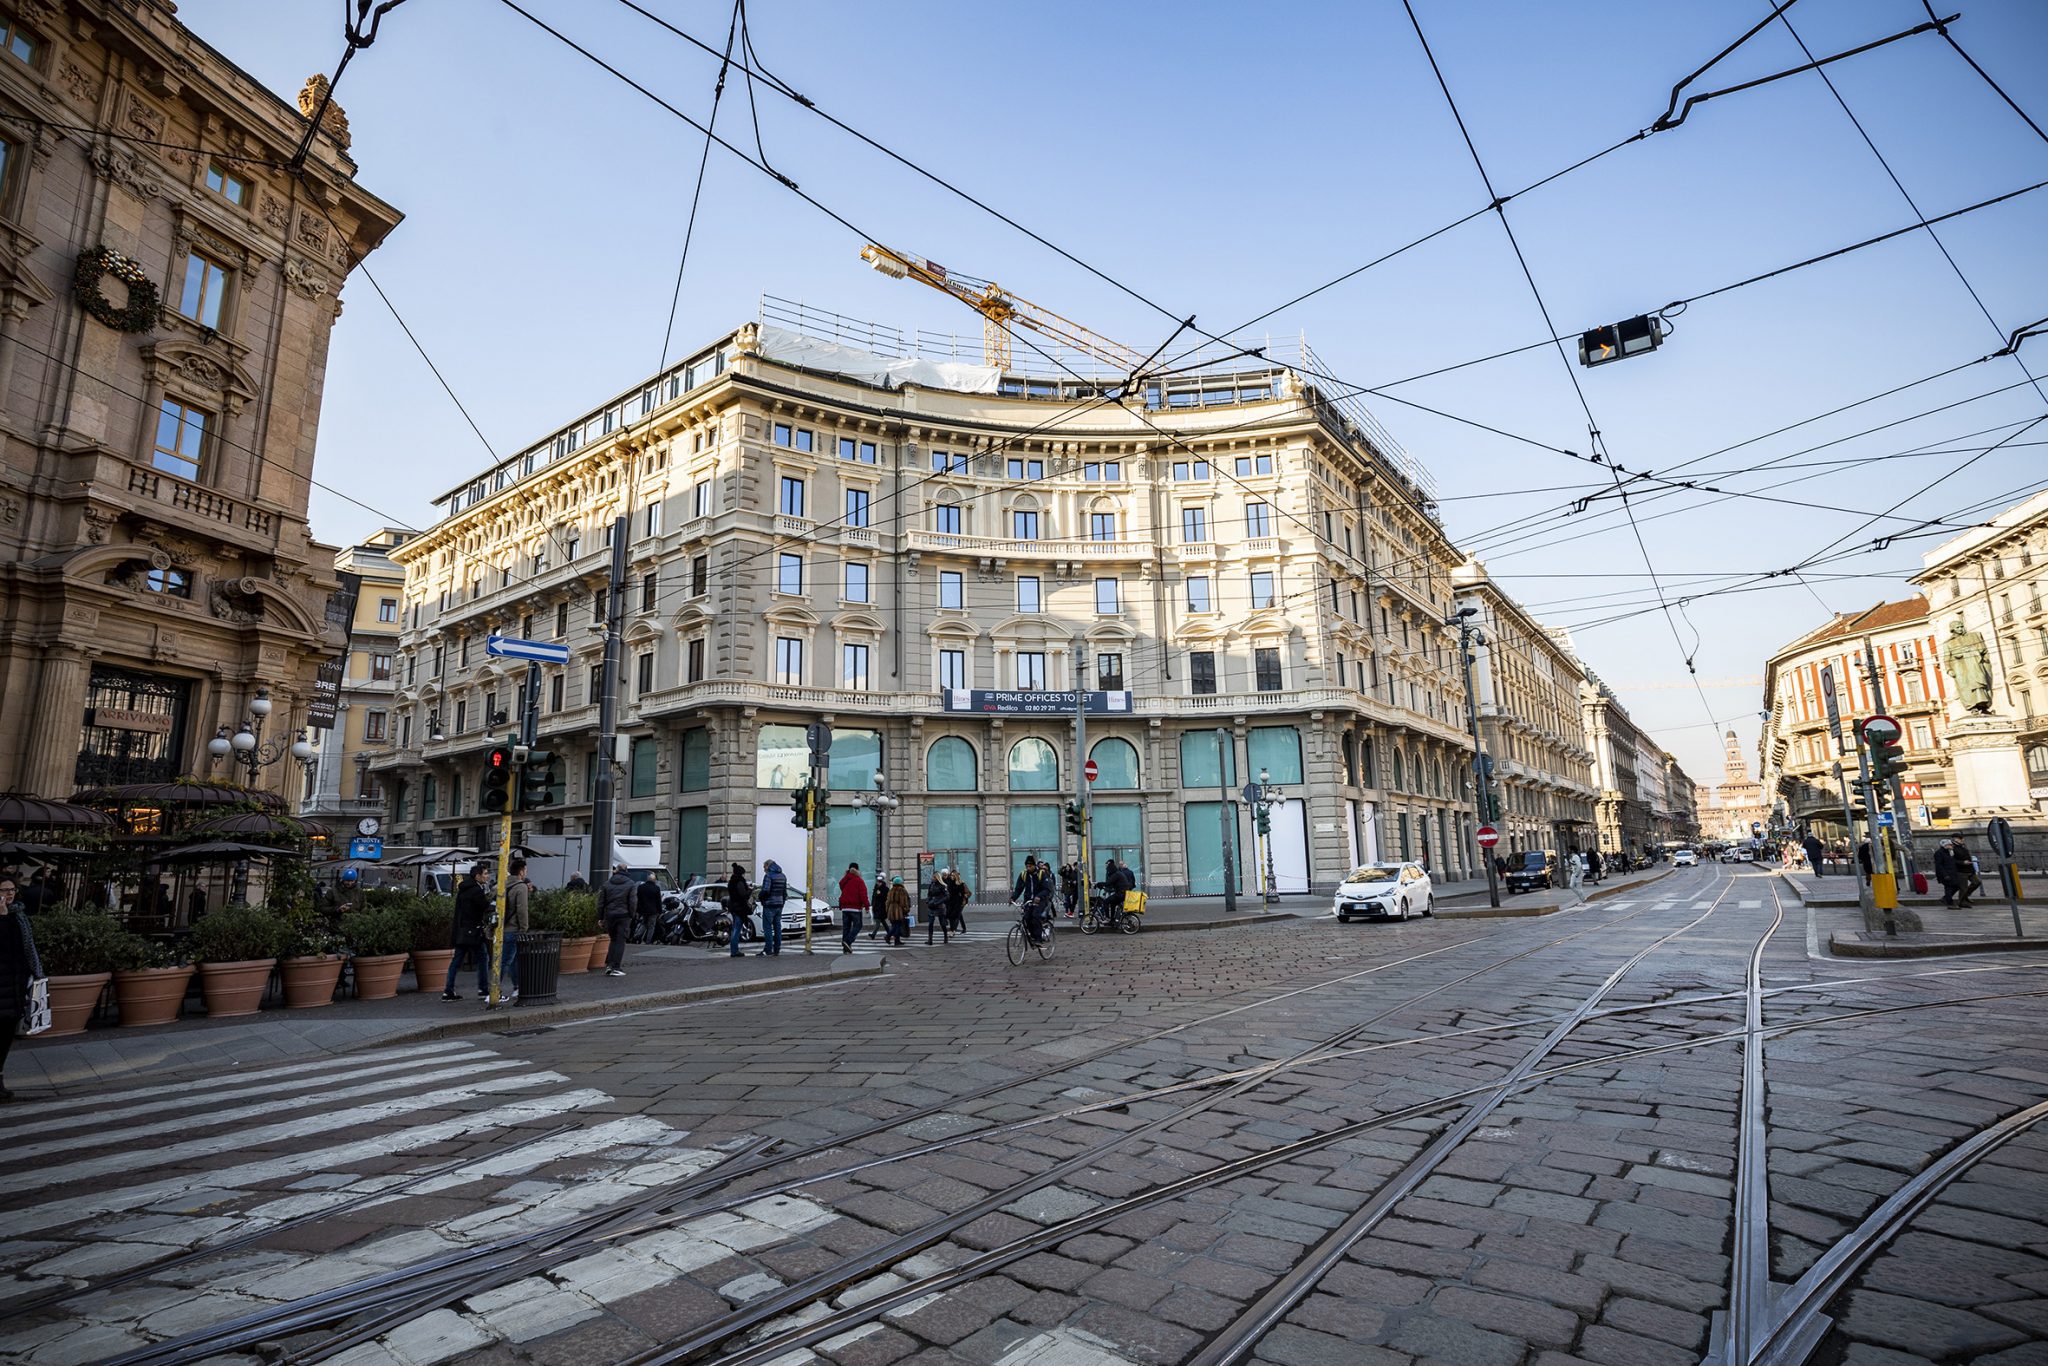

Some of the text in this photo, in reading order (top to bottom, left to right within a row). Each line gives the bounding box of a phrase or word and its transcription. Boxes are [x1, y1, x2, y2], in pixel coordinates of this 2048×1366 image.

[996, 693, 1094, 702] PRIME OFFICES TO ET
[997, 704, 1019, 712] Redilco
[98, 710, 170, 726] ARRIVIAMO
[1903, 785, 1920, 797] M
